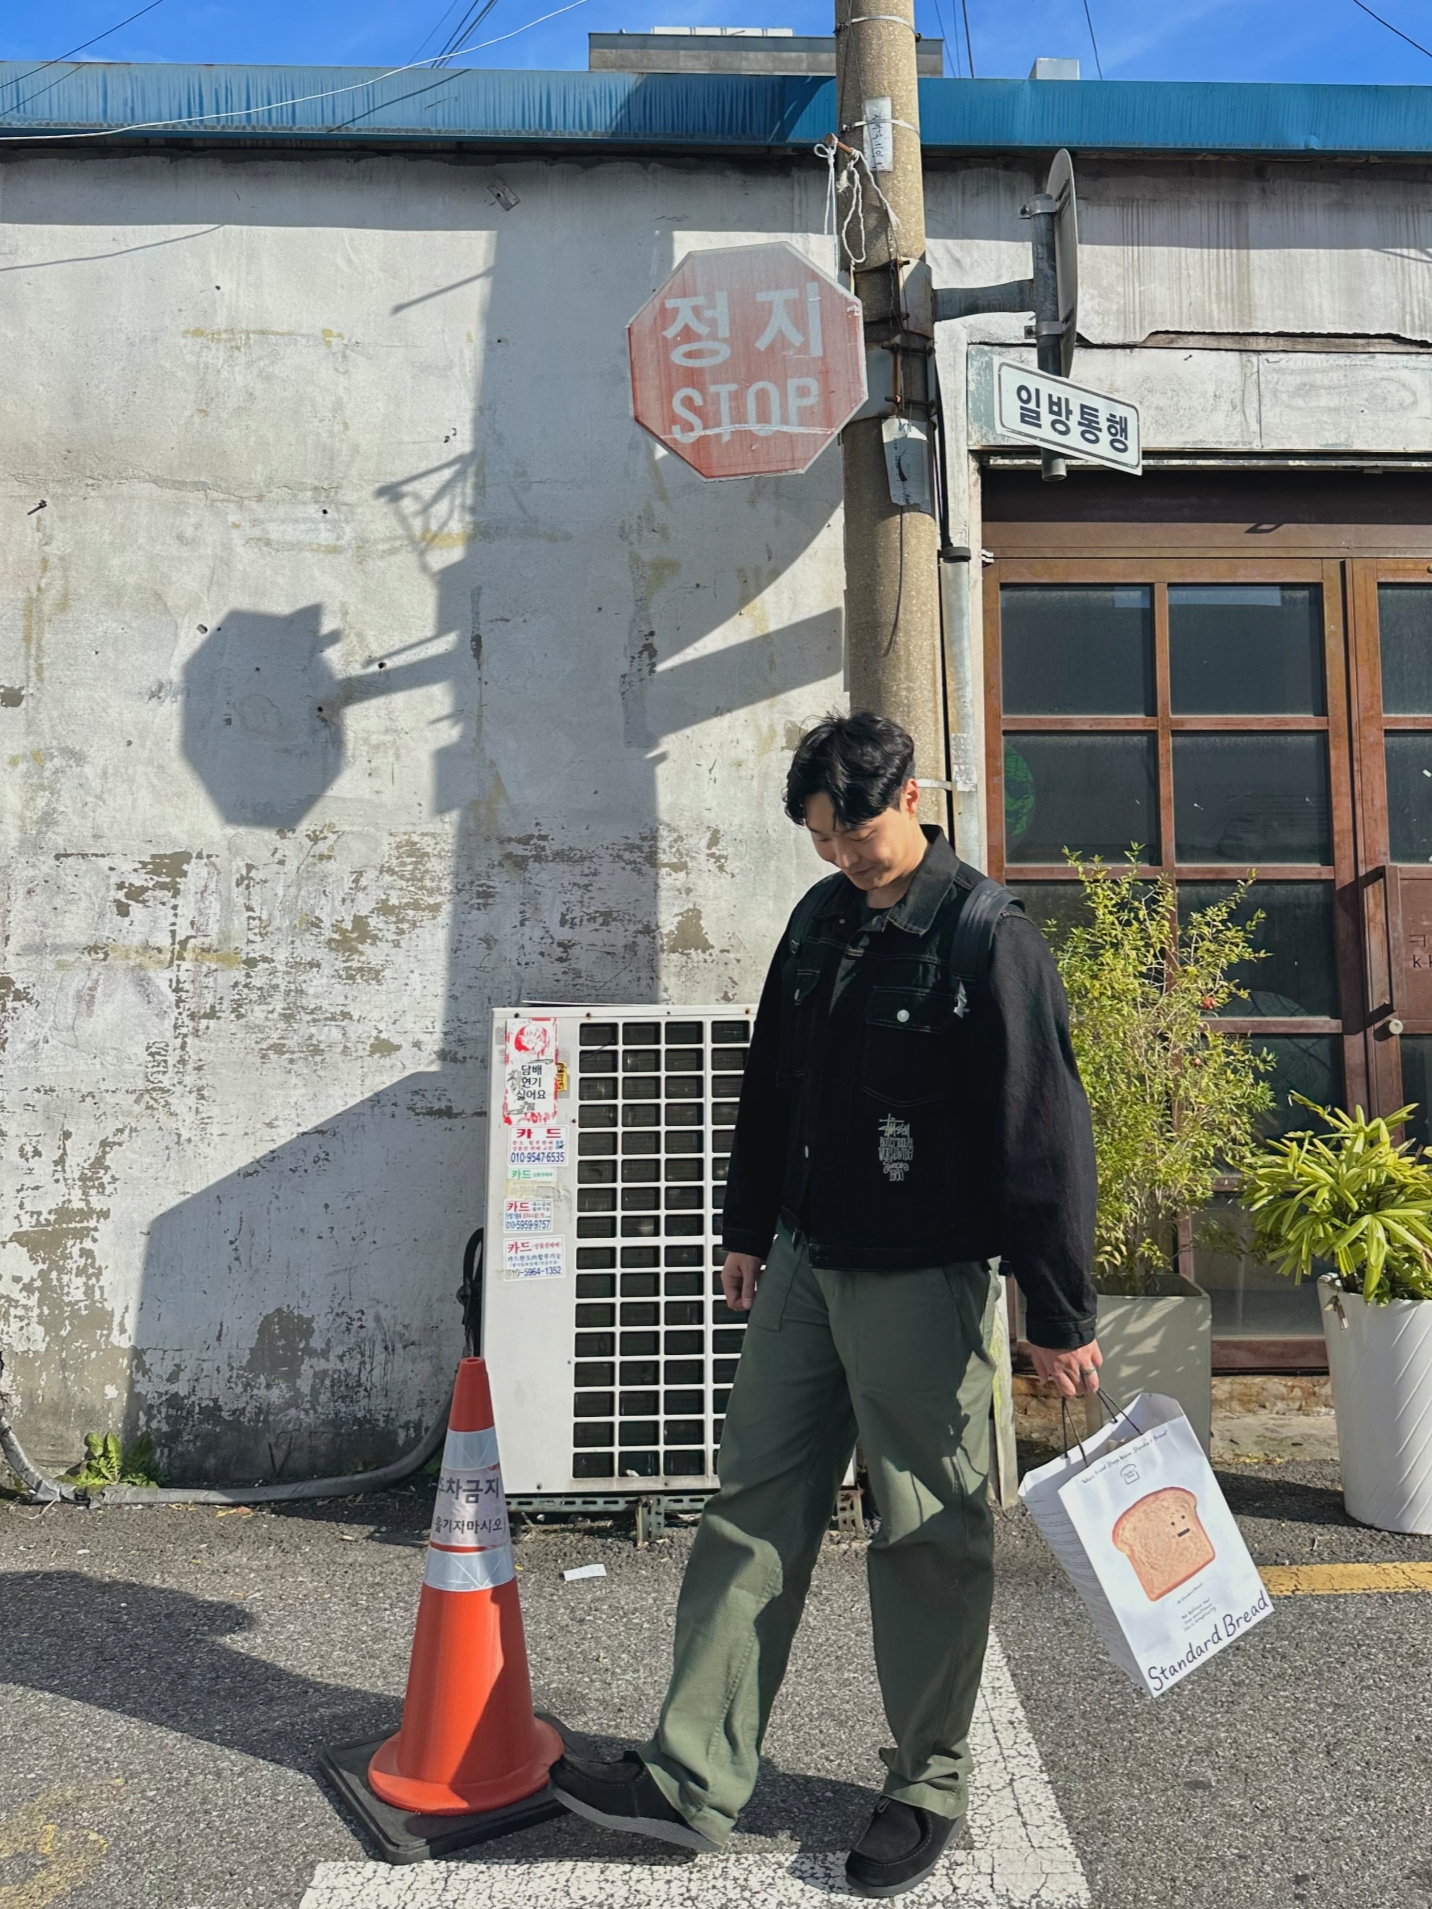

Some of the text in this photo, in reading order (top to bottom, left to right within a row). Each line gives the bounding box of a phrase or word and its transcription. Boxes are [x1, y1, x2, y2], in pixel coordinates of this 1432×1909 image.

[662, 282, 823, 368] 정지
[671, 377, 819, 444] STOP
[1016, 384, 1129, 454] 일방통행
[521, 1064, 542, 1076] 담배
[521, 1076, 542, 1089] 연기
[516, 1089, 547, 1101] 싫어요
[511, 1169, 531, 1180] 카드
[506, 1201, 530, 1212] 카드
[507, 1241, 532, 1254] 카드
[1148, 1589, 1269, 1692] Standard Bread
